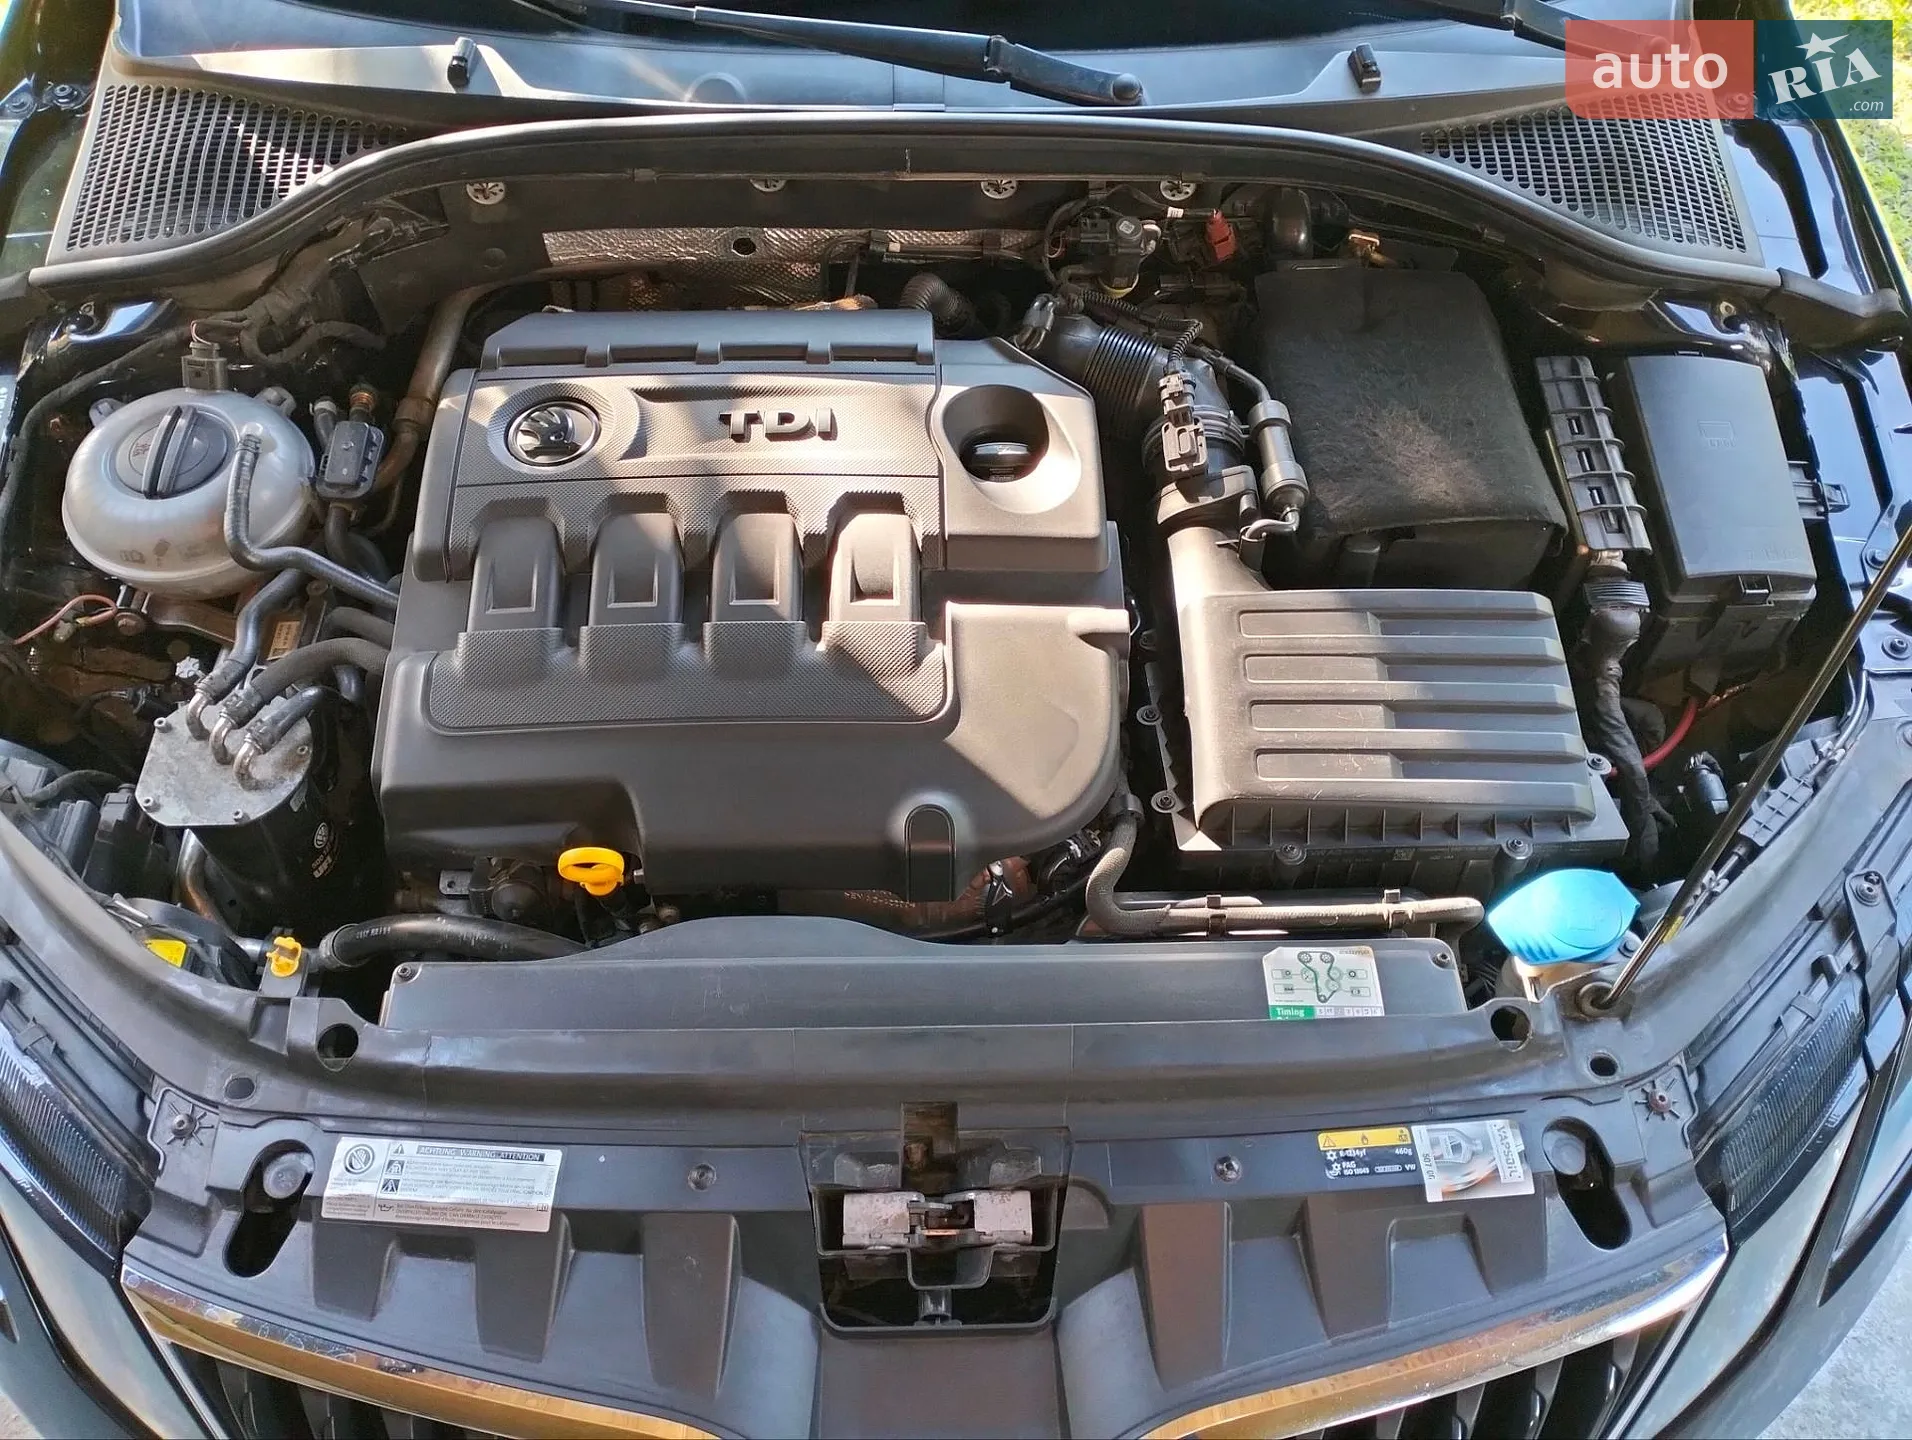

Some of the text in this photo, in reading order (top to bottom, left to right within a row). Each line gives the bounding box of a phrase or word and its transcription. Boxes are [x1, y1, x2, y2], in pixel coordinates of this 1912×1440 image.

[719, 407, 836, 442] TDI
[1276, 1007, 1304, 1017] Timing
[419, 1146, 541, 1162] ACHTUNG WARNING ATTENTION
